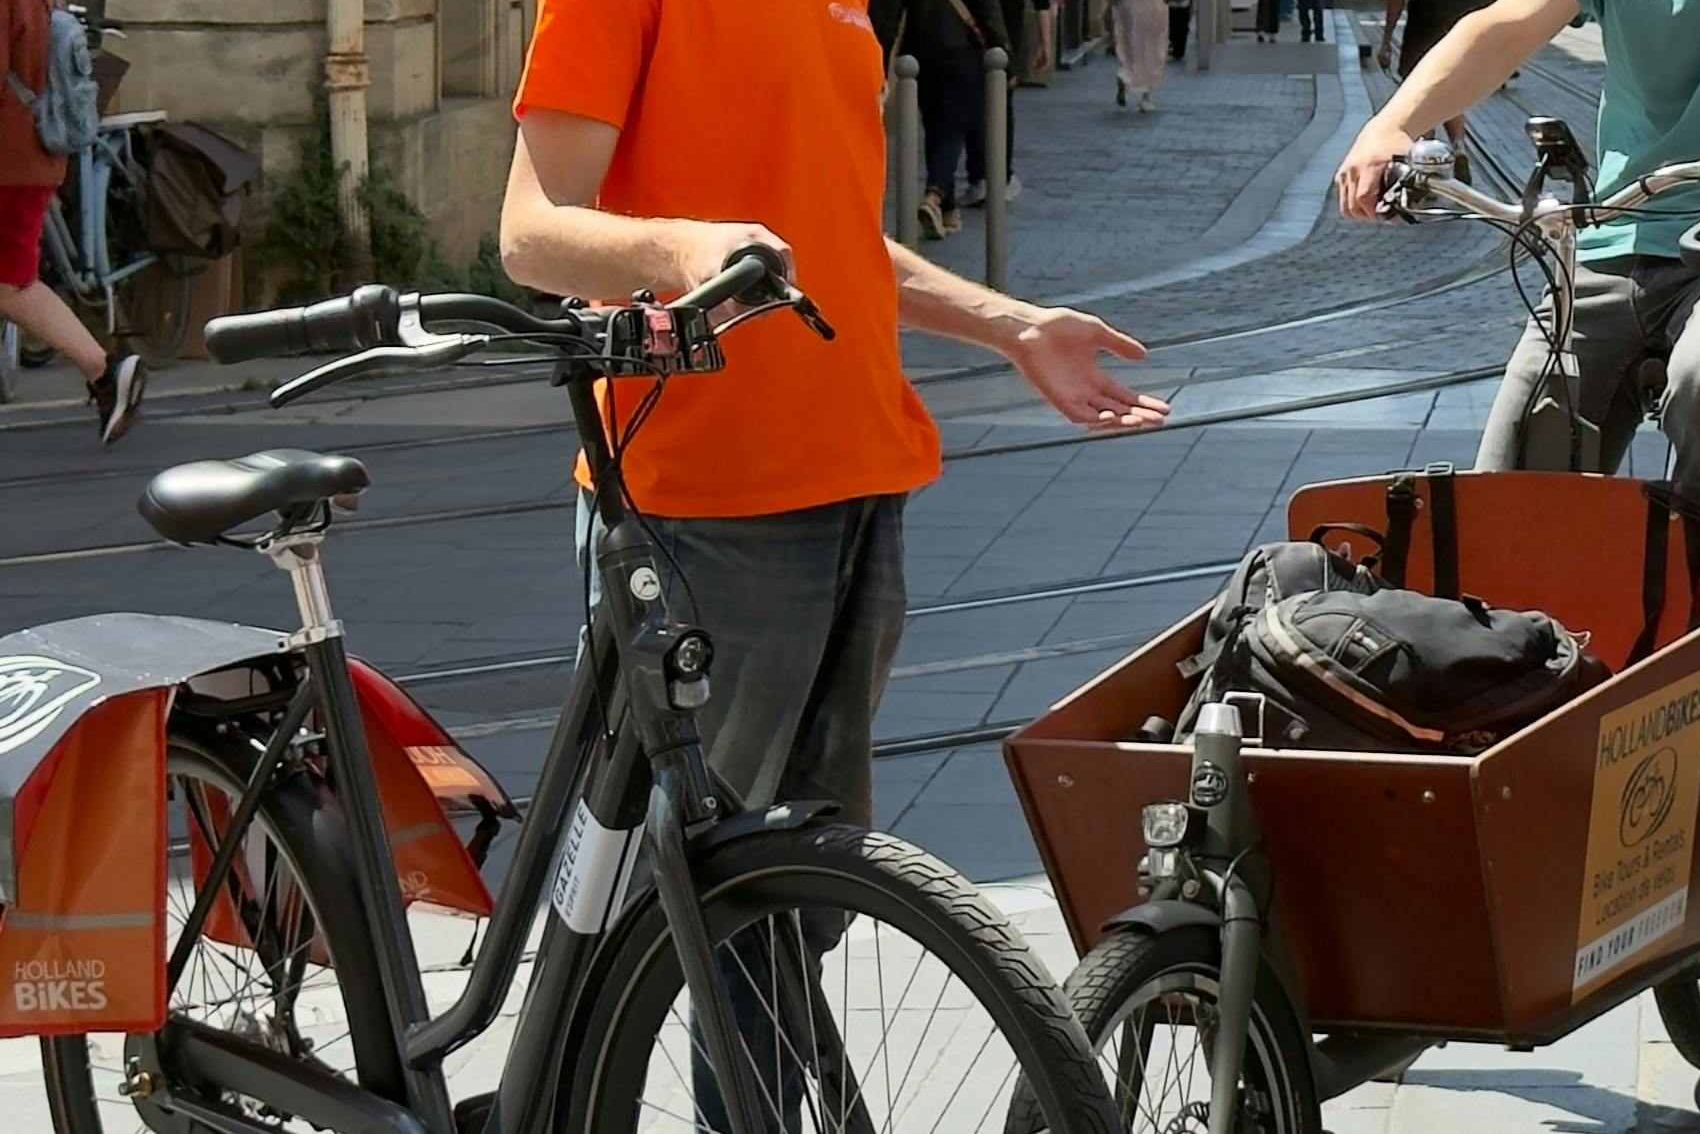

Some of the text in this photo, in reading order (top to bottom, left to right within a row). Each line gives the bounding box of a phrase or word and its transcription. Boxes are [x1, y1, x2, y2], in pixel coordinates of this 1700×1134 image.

[554, 806, 588, 906] GAZELLE
[15, 959, 106, 979] HOLLAND
[1577, 946, 1603, 978] FIND
[1607, 926, 1635, 959] YOUR
